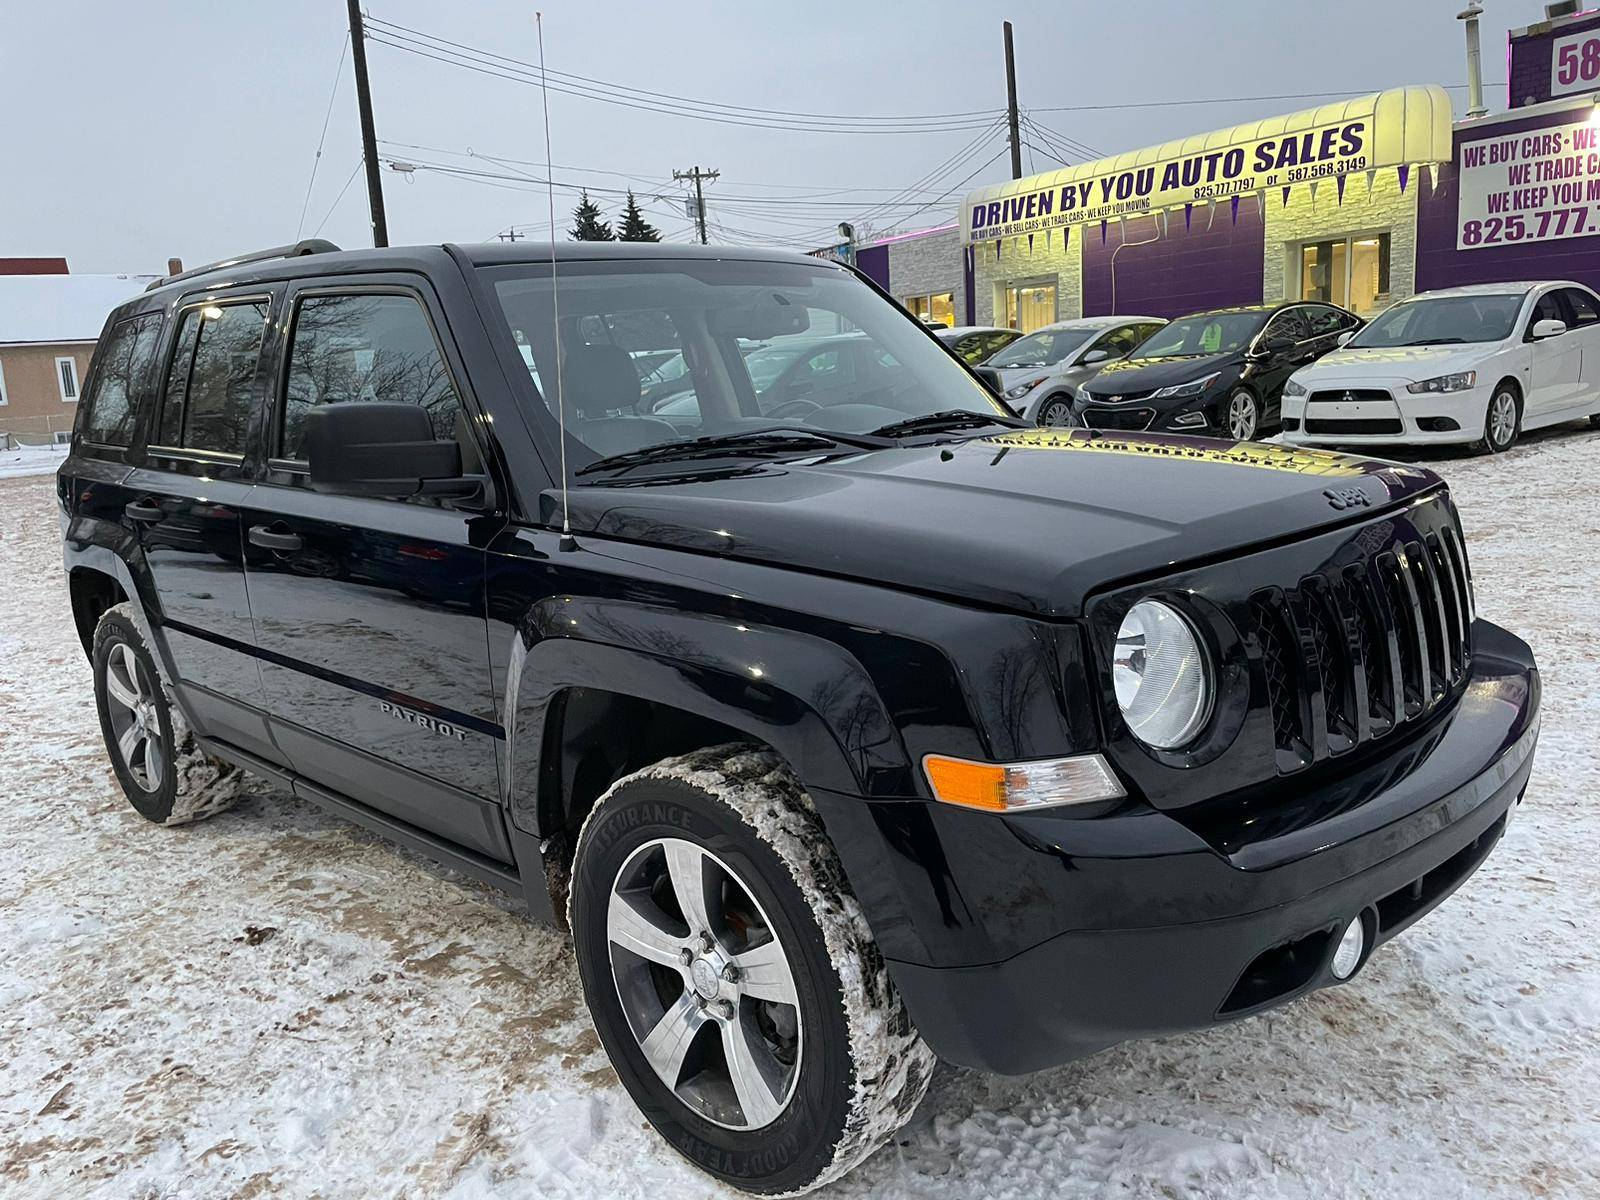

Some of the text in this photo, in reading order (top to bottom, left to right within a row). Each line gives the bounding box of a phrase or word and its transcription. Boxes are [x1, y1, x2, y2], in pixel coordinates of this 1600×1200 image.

[1558, 39, 1600, 85] 58
[1464, 127, 1597, 168] WE BUY CARS WE
[971, 122, 1365, 229] DRIVEN BY YOU AUTO SALES
[1194, 156, 1366, 199] 825.777.7797 or 587.568.3149
[1508, 153, 1600, 186] WE TRADE C
[1004, 224, 1013, 234] WE
[1013, 221, 1024, 233] SELL
[1025, 219, 1039, 231] CARS
[1042, 217, 1050, 228] WE
[1051, 213, 1068, 226] TRADE
[1069, 210, 1084, 223] CARS
[1087, 207, 1097, 219] WE
[1098, 205, 1112, 217] KEEP
[1112, 201, 1124, 214] YOU
[1125, 197, 1150, 212] MOVING
[1487, 191, 1510, 214] WE
[1513, 186, 1548, 211] KEEP
[1552, 181, 1582, 205] YOU
[1463, 203, 1600, 246] 825.777.
[1322, 487, 1371, 511] Jeep
[380, 701, 468, 741] PATRIOT
